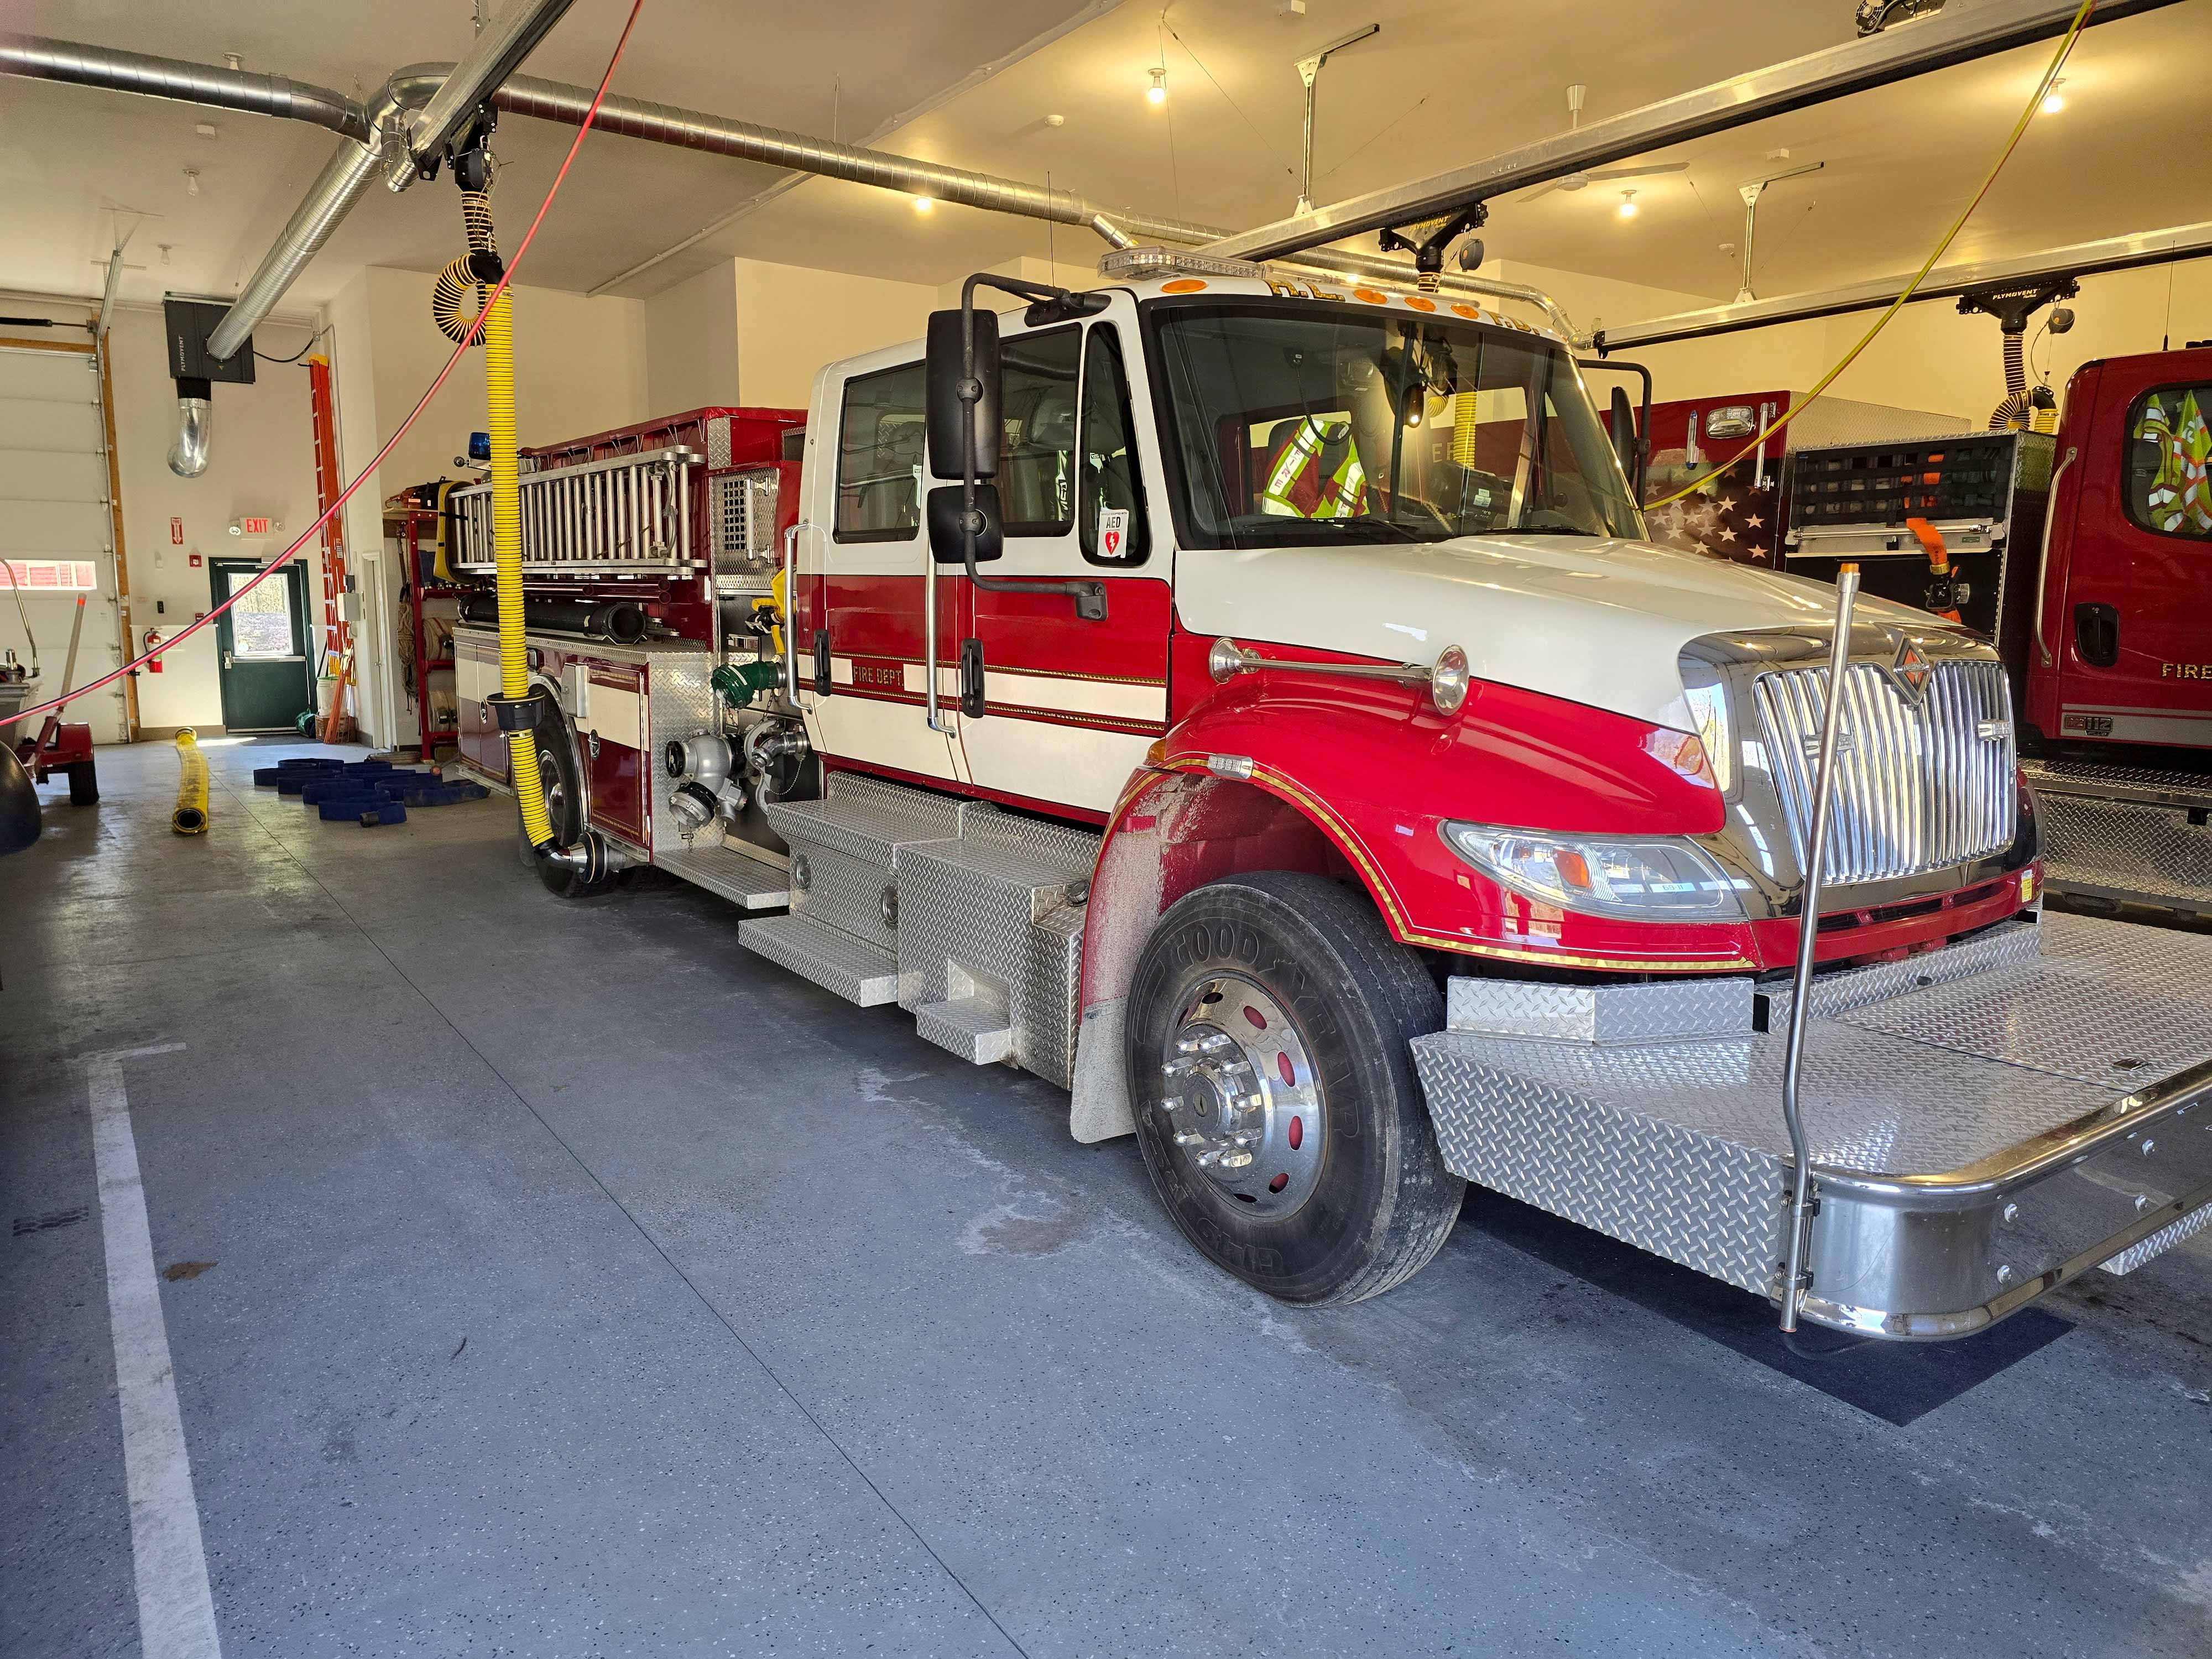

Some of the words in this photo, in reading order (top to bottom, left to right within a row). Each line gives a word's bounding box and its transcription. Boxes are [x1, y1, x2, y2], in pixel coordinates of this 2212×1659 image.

[1409, 215, 1449, 231] PLYMOVENT
[1992, 289, 2038, 300] PLYMOVENT
[1274, 449, 1301, 488] FIRE
[246, 519, 268, 533] EXIT
[1106, 517, 1121, 529] AED
[853, 666, 874, 683] FIRE
[877, 668, 904, 686] DEPT.
[2162, 663, 2212, 679] FIRE
[2087, 717, 2111, 730] 112
